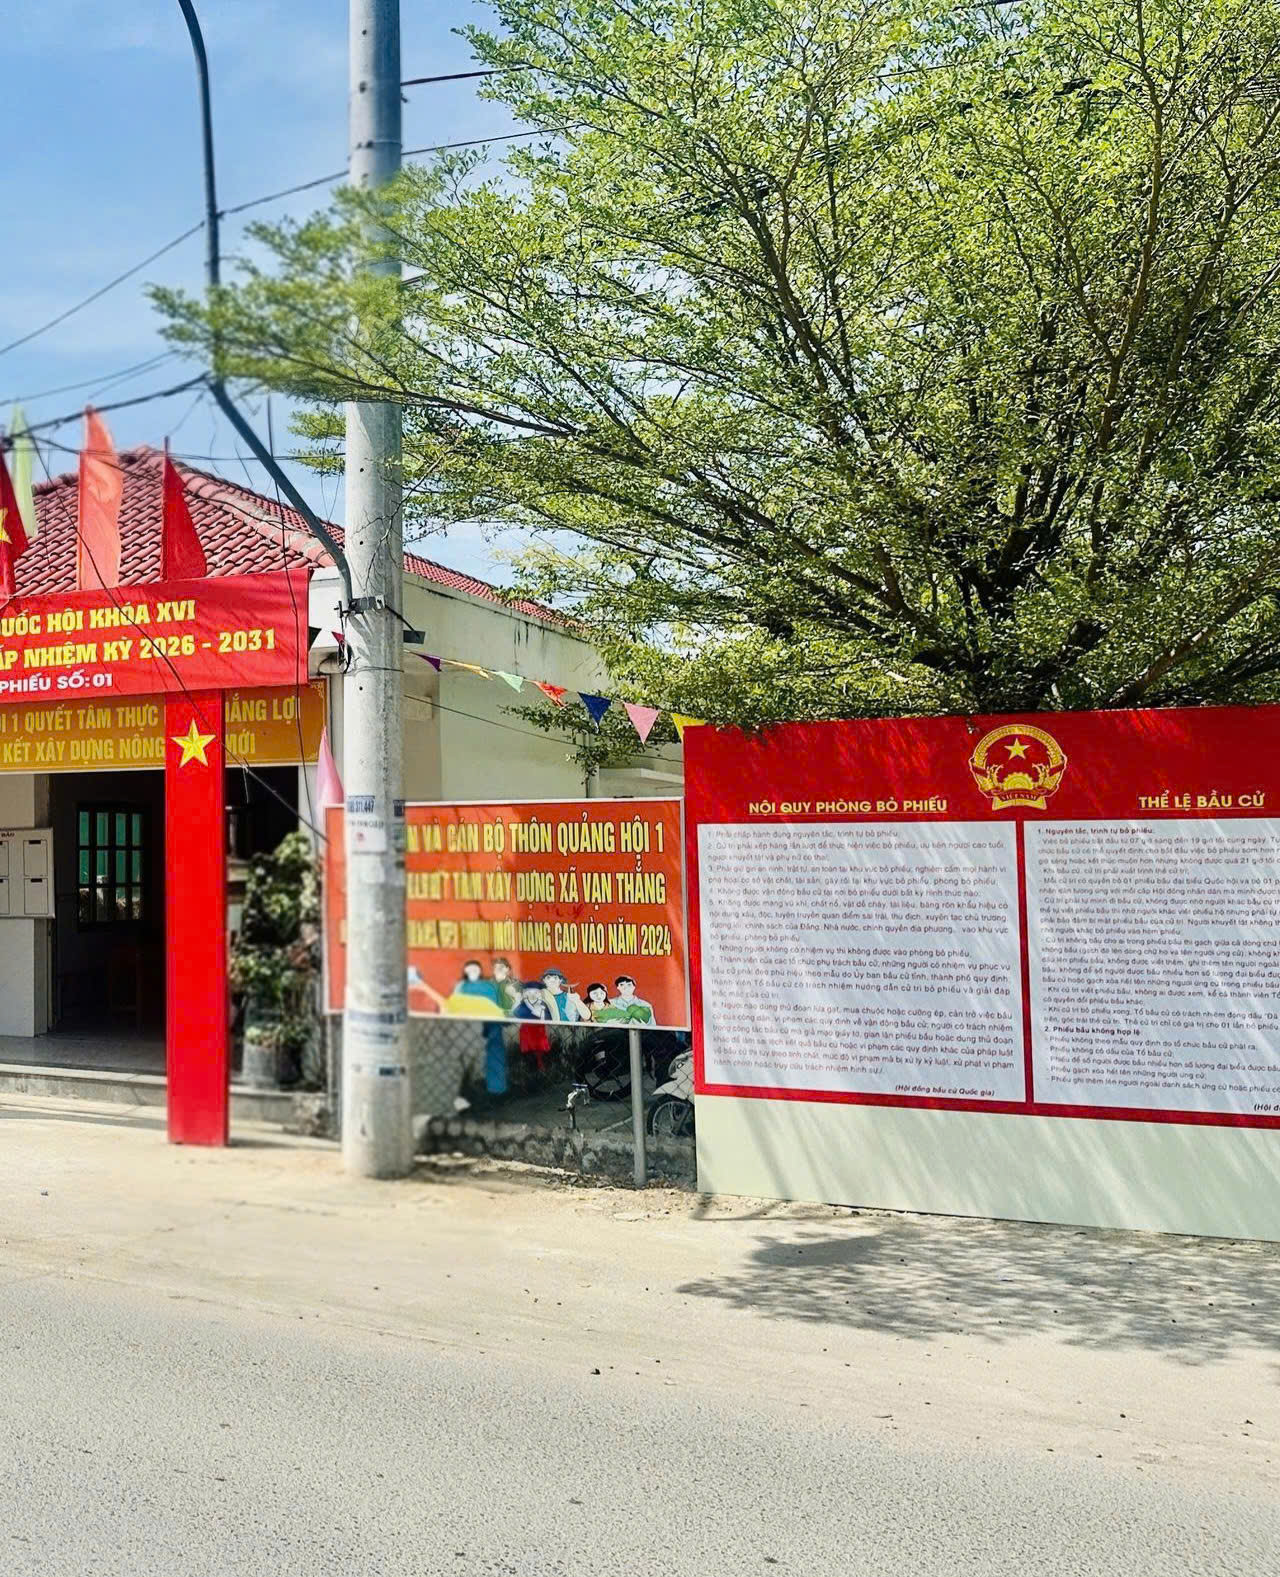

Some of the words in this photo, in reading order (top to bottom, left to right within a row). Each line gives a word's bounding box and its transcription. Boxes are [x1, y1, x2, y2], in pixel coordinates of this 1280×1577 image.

[47, 608, 83, 635] HỘI
[89, 602, 150, 629] KHÓA
[156, 600, 196, 621] XVI
[24, 642, 97, 670] NHIỆM
[103, 637, 133, 661] KỲ
[139, 635, 195, 659] 2026
[219, 628, 276, 653] 2031
[12, 712, 18, 732] 1
[25, 704, 72, 734] QUYẾT
[77, 705, 111, 729] TÂM
[116, 704, 159, 731] THỰC
[225, 693, 267, 722] ẮNG
[3, 736, 31, 763] KẾT
[35, 737, 66, 762] XÂY
[70, 737, 114, 764] DỰNG
[119, 733, 165, 759] NÔNG
[749, 799, 775, 816] NỘI
[780, 802, 811, 813] QUY
[816, 798, 872, 813] PHÒNG
[876, 796, 898, 812] BỎ
[903, 795, 947, 812] PHIẾU
[1139, 790, 1170, 808] THỂ
[1174, 793, 1191, 811] LỆ
[1197, 789, 1232, 807] BẦU
[1238, 790, 1265, 806] CỬ
[422, 818, 442, 853] VÀ
[447, 817, 479, 853] CÁN
[483, 816, 505, 859] BỘ
[509, 816, 552, 853] THÔN
[557, 811, 616, 856] QUẢNG
[620, 815, 650, 859] HỘI
[655, 822, 664, 853] 1
[486, 866, 512, 902] XÂY
[516, 870, 555, 909] DỰNG
[559, 866, 579, 903] XÃ
[582, 872, 612, 910] VẠN
[616, 861, 666, 904] THẮNG
[518, 915, 551, 952] NÂNG
[554, 923, 578, 953] CAO
[581, 917, 605, 954] VÀO
[607, 917, 637, 955] NĂM
[641, 925, 671, 956] 2024
